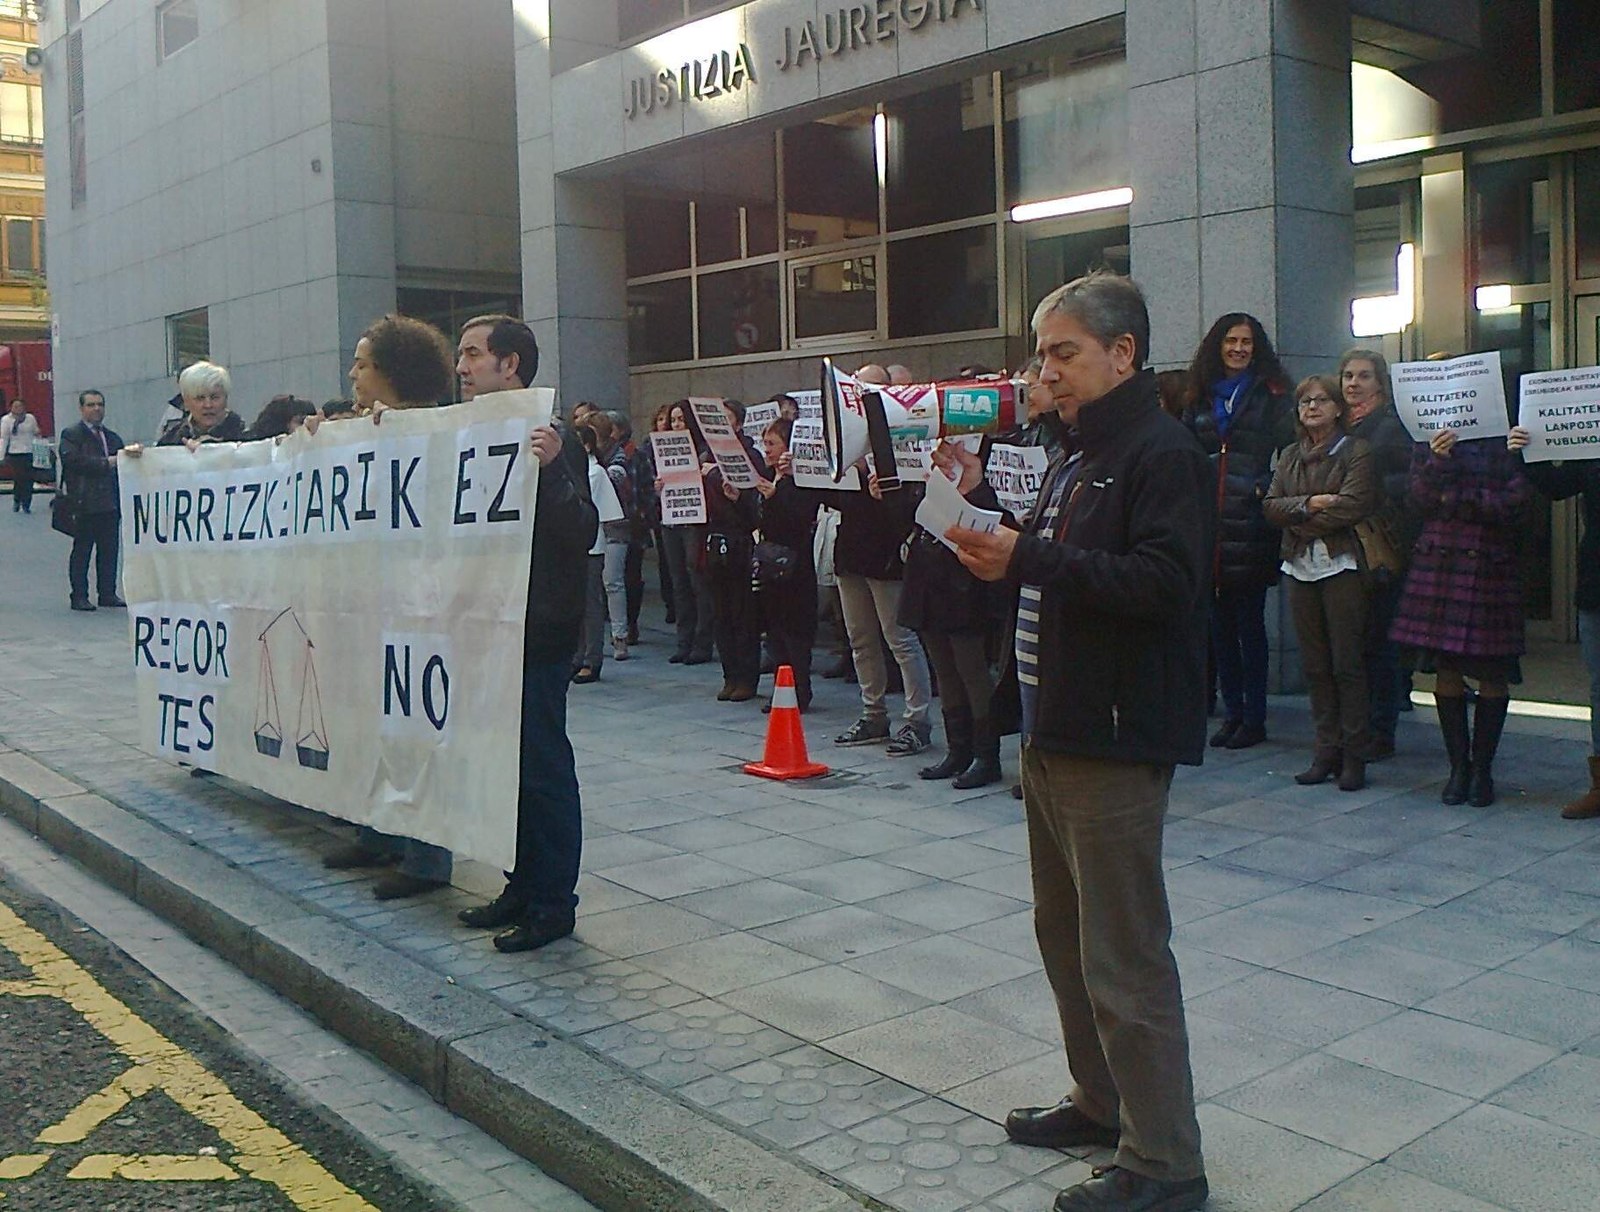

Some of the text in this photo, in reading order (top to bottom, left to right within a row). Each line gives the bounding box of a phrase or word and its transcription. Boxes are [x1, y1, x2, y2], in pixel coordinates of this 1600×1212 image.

[624, 41, 757, 120] JUSTIZIA
[948, 393, 992, 413] ELA
[1412, 390, 1477, 404] KALITATEKO
[1417, 405, 1474, 417] LANPOSTU
[1418, 418, 1479, 430] PUBLIKOAK
[453, 442, 520, 525] EZ
[135, 616, 229, 678] RECOR
[384, 645, 449, 731] NO
[158, 694, 214, 752] TES
